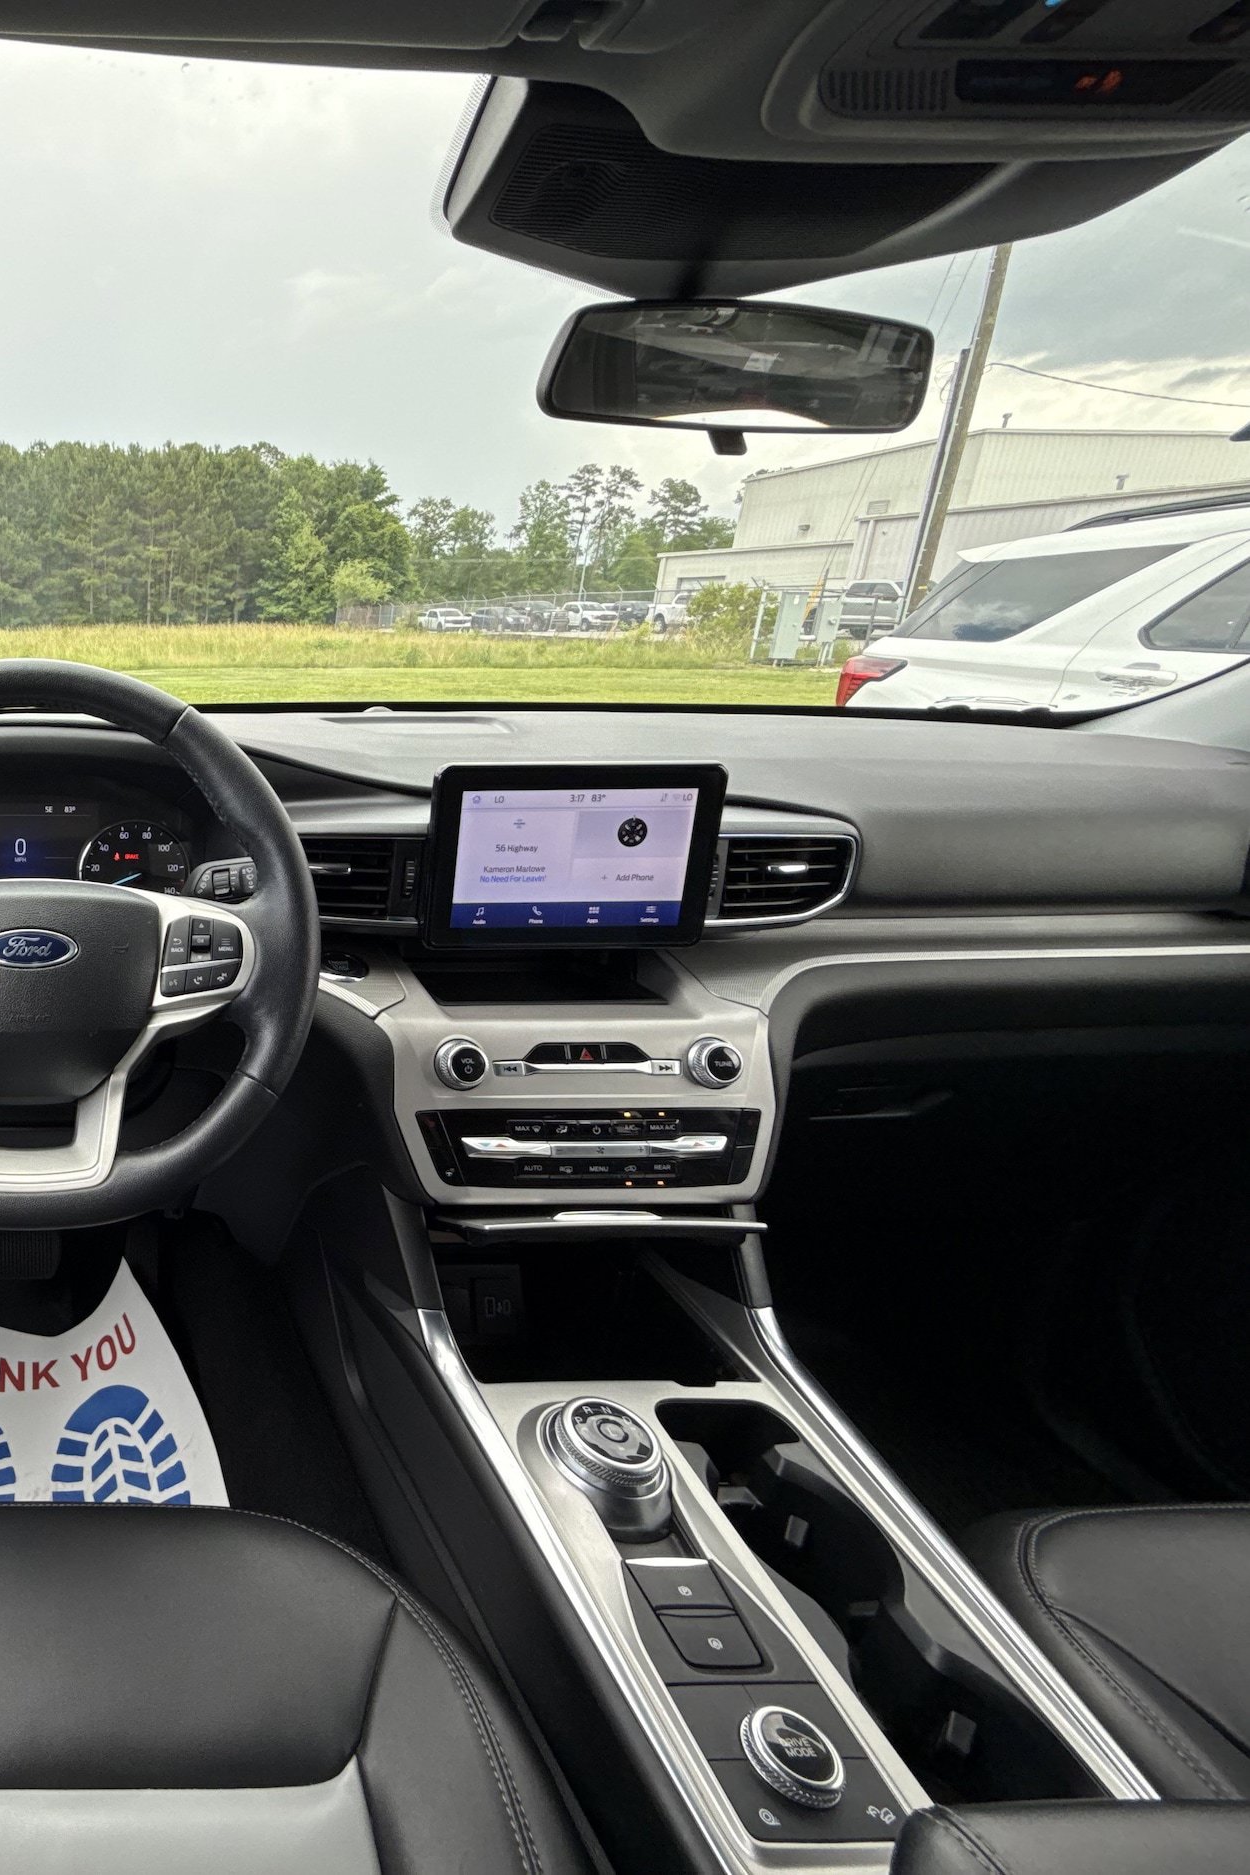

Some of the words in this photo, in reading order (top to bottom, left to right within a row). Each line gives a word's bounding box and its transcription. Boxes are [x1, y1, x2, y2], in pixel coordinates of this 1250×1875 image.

[570, 794, 585, 802] 3:17
[682, 793, 693, 801] LO
[44, 805, 54, 813] SE
[119, 831, 130, 840] 60
[142, 831, 152, 840] 80
[14, 838, 27, 856] 0
[99, 844, 110, 852] 40
[157, 843, 170, 852] 100
[495, 844, 506, 853] 56
[507, 844, 538, 854] Highway
[90, 863, 100, 872] 20
[167, 864, 179, 872] 120
[483, 865, 515, 873] Kameron
[516, 865, 546, 873] Marlowe
[479, 875, 490, 883] No
[491, 875, 509, 883] Need
[631, 873, 654, 881] Phone
[164, 886, 176, 895] 140
[2, 936, 53, 957] Ford
[70, 1312, 137, 1381] YOU
[581, 1405, 593, 1415] R
[601, 1405, 613, 1415] N
[574, 1416, 583, 1425] P
[777, 1737, 811, 1748] DRIVE
[784, 1747, 817, 1758] MODE
